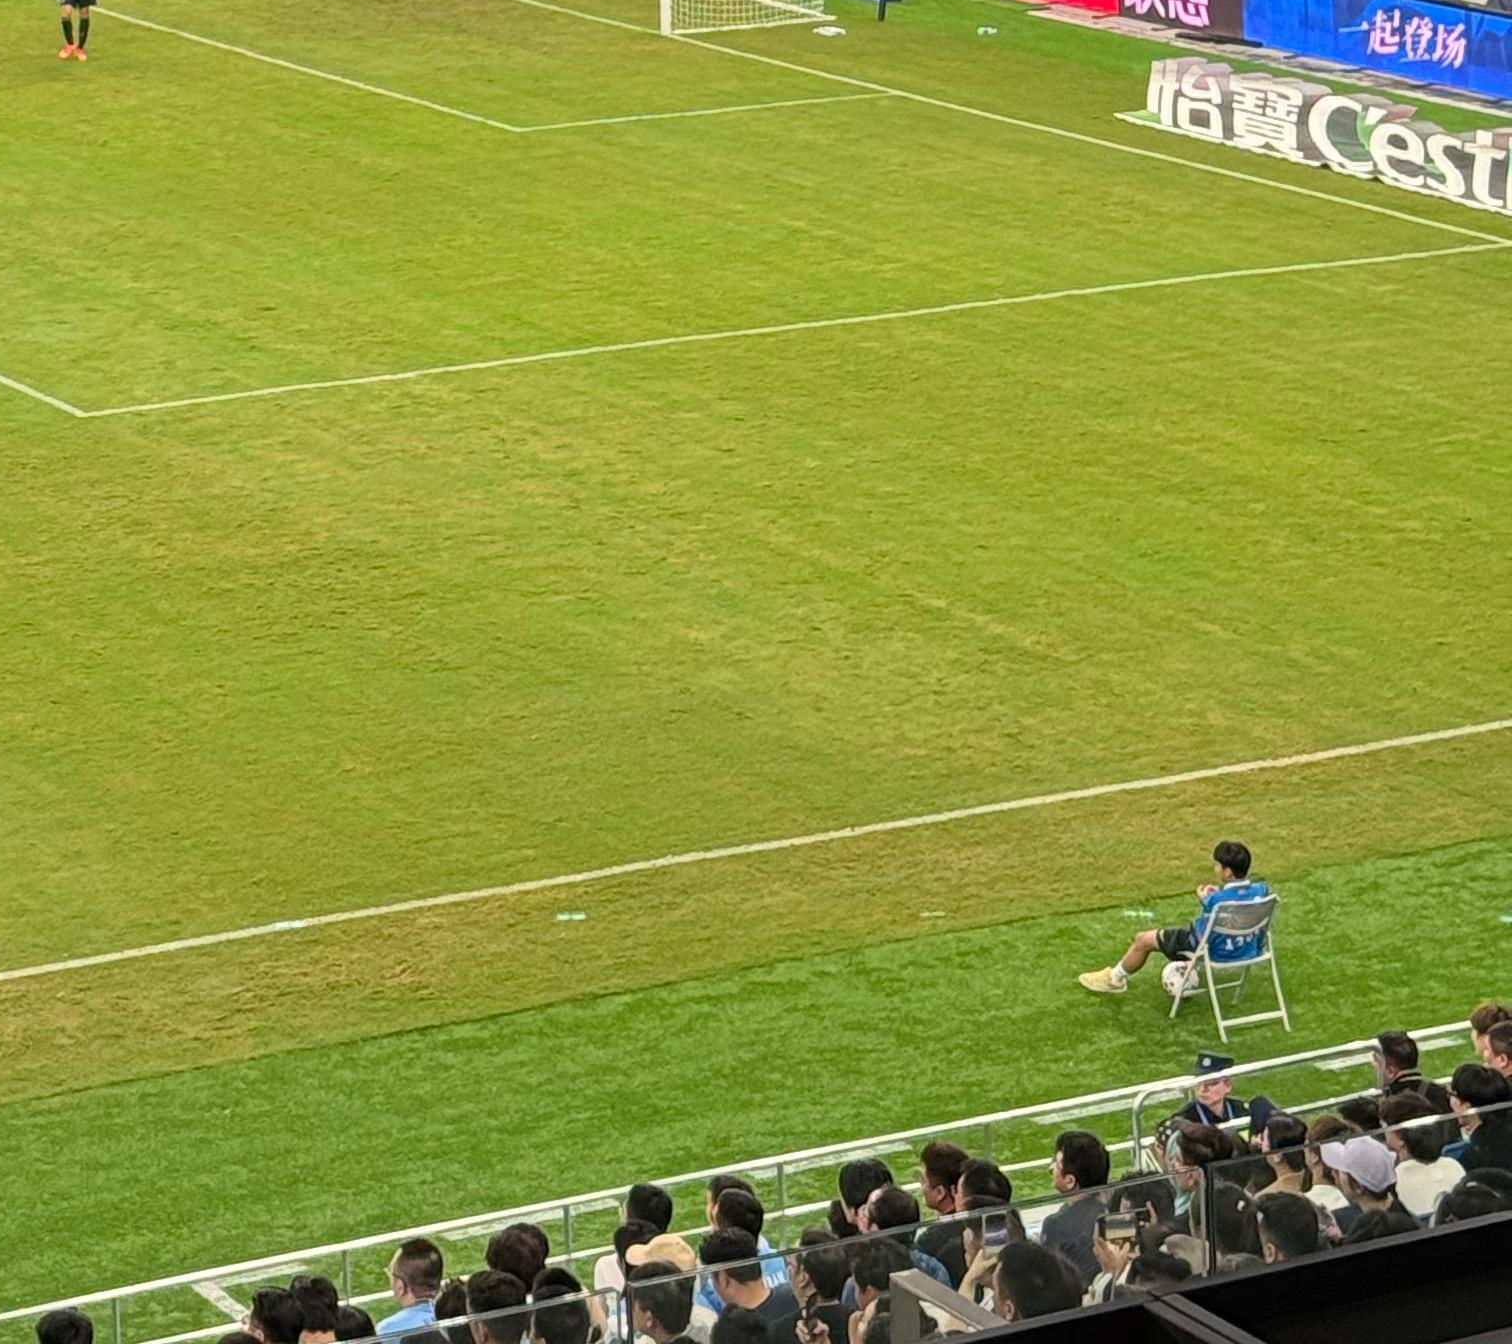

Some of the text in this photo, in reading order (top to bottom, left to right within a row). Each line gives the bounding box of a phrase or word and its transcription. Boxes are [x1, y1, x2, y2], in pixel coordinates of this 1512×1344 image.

[1339, 8, 1467, 70] 一起登场
[1307, 93, 1512, 210] C'est
